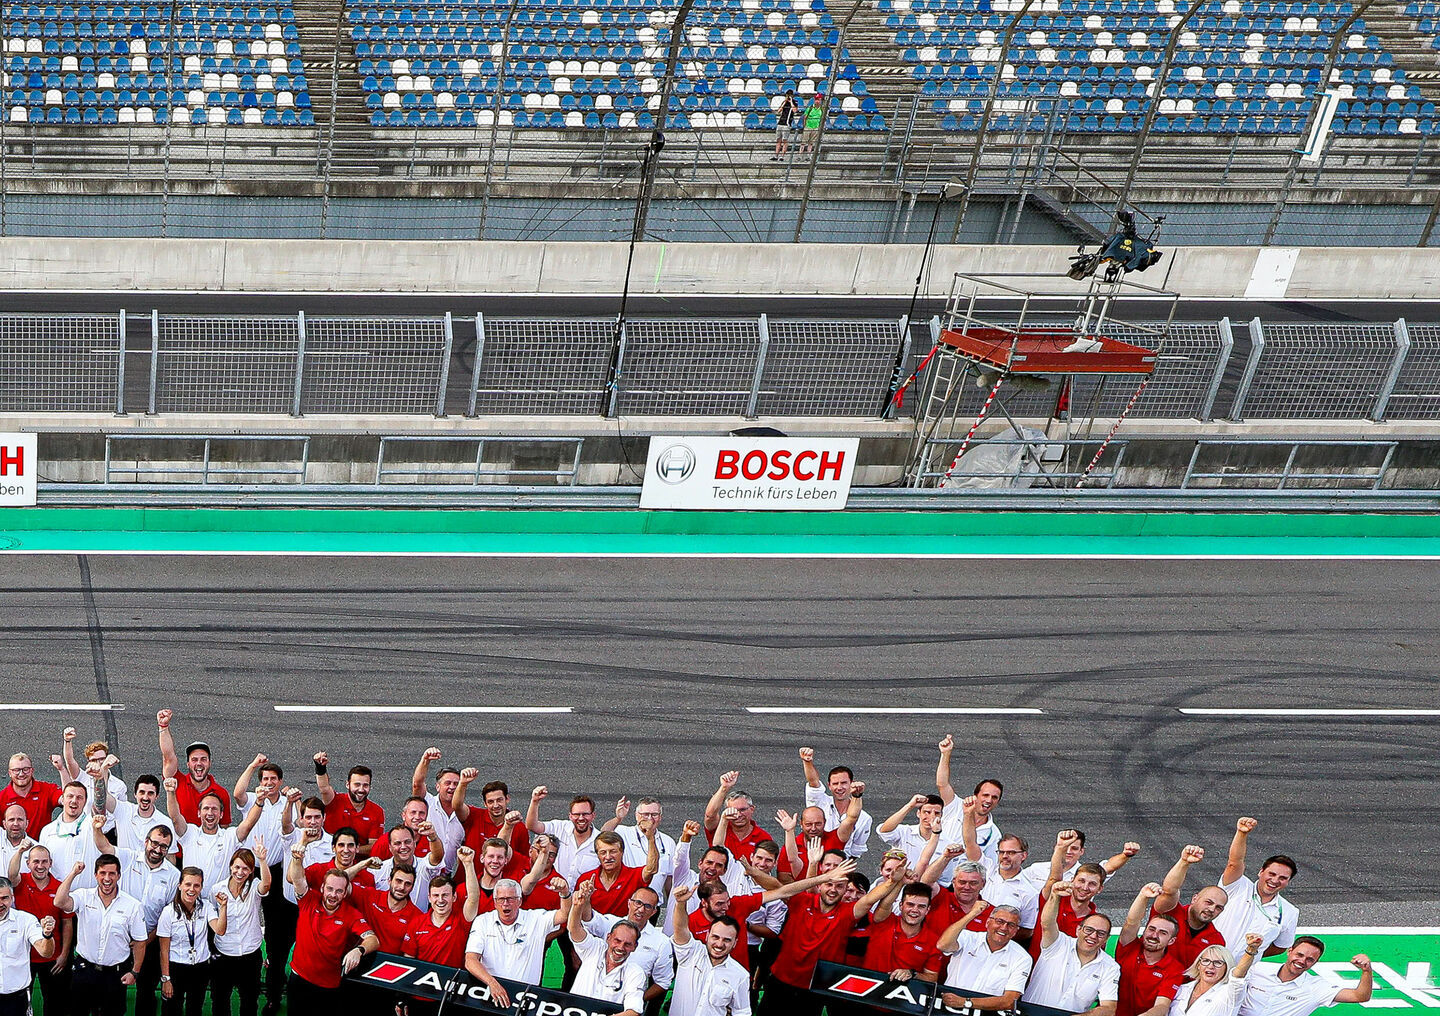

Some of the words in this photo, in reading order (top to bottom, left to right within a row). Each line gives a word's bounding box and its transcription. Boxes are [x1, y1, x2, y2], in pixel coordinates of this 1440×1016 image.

[714, 450, 845, 481] BOSCH
[712, 486, 764, 500] Technik
[766, 486, 793, 500] fürs
[796, 487, 837, 500] Leben
[413, 970, 492, 1000] Aud
